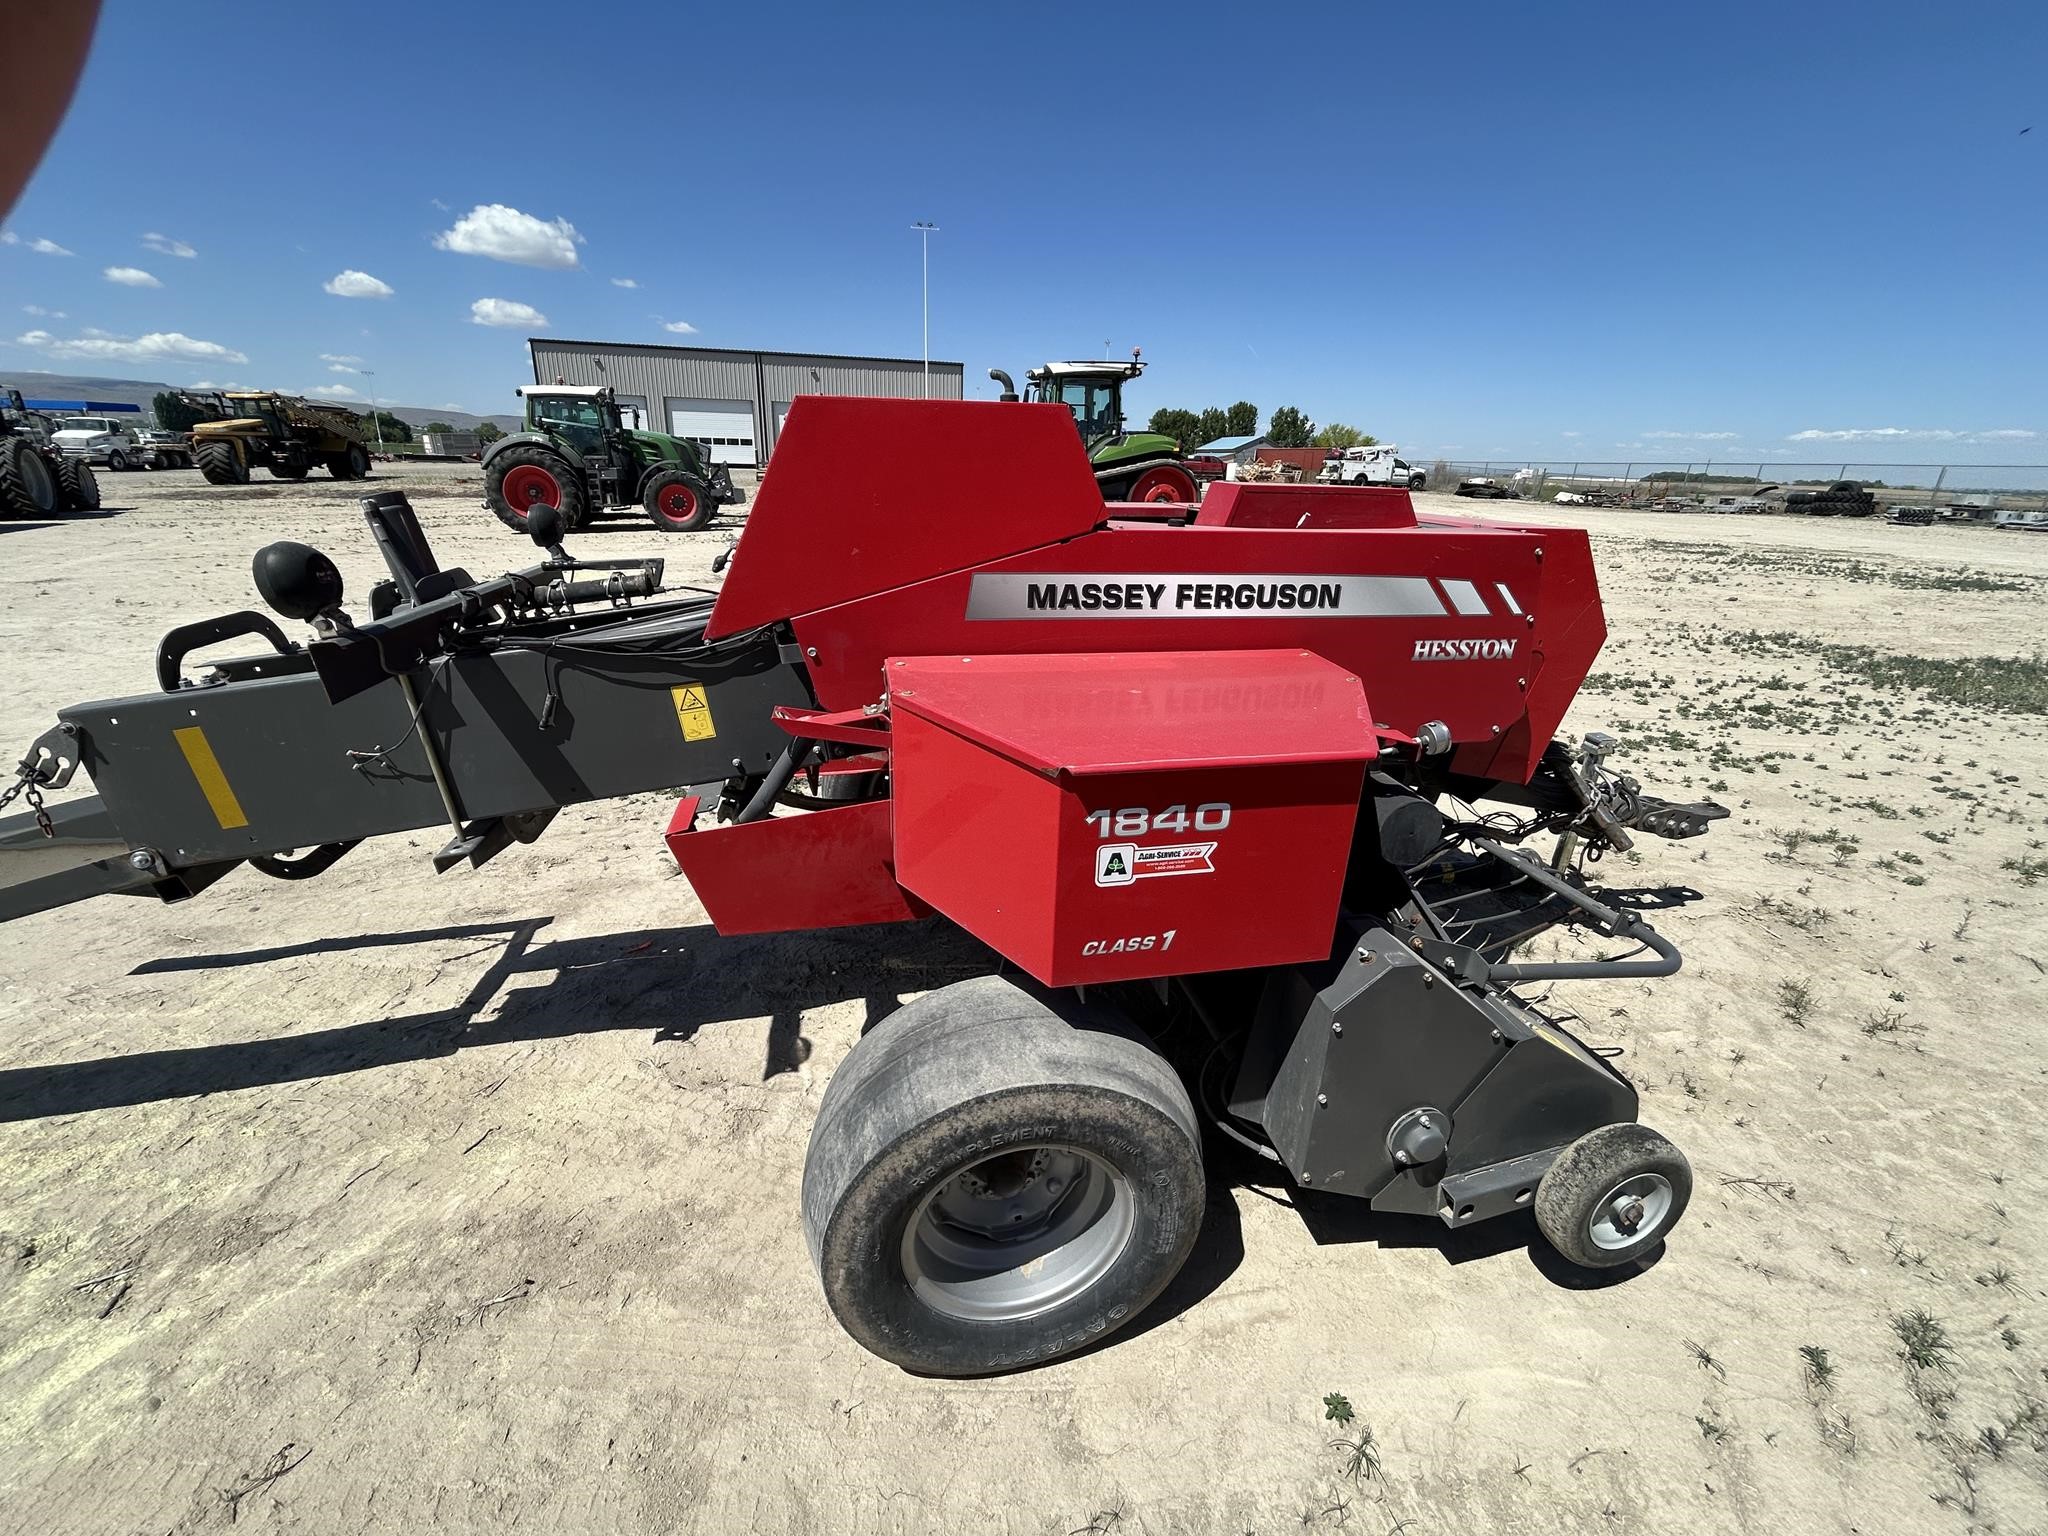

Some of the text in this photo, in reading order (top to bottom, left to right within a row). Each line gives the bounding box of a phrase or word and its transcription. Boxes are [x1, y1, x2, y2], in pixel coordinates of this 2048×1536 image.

[1026, 583, 1342, 611] MASSEY FERGUSON
[1411, 639, 1518, 661] HESSTON
[1086, 803, 1231, 838] 1840
[1082, 930, 1177, 956] CLASS 1
